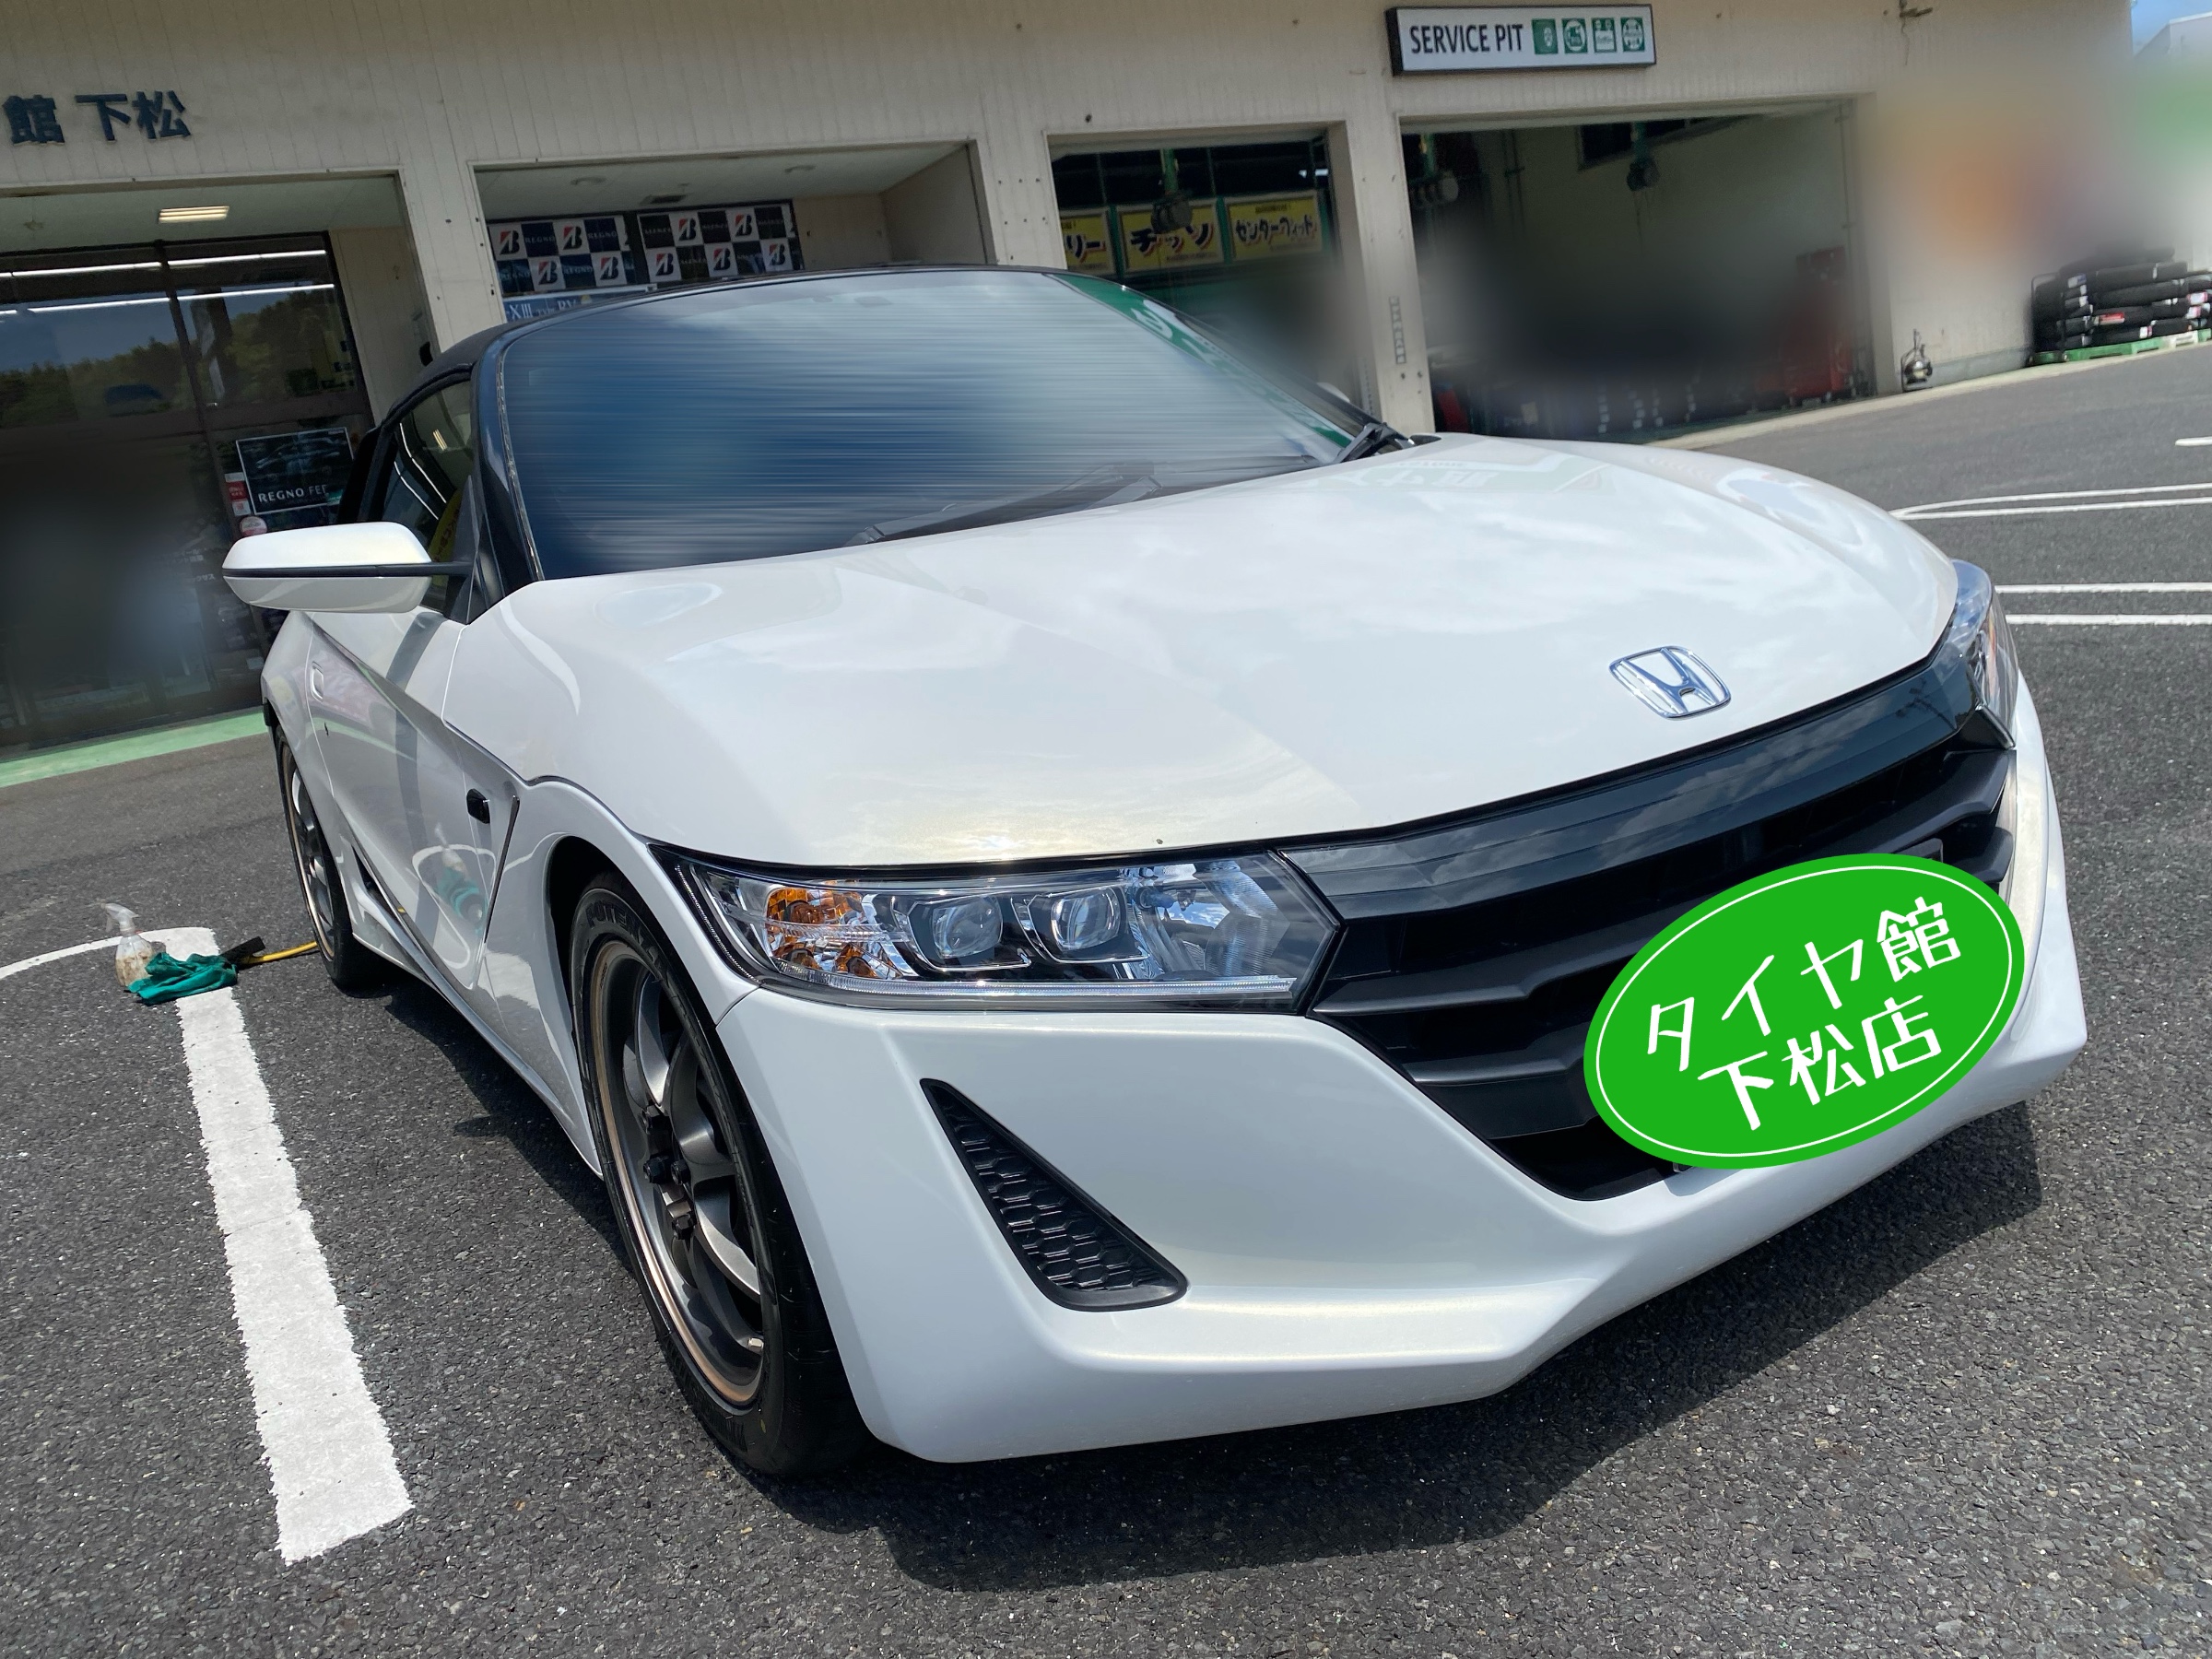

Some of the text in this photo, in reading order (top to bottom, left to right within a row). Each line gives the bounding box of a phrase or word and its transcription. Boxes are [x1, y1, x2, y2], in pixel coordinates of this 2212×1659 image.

[1410, 24, 1524, 53] SERVICE PIT
[258, 488, 304, 503] REGNO
